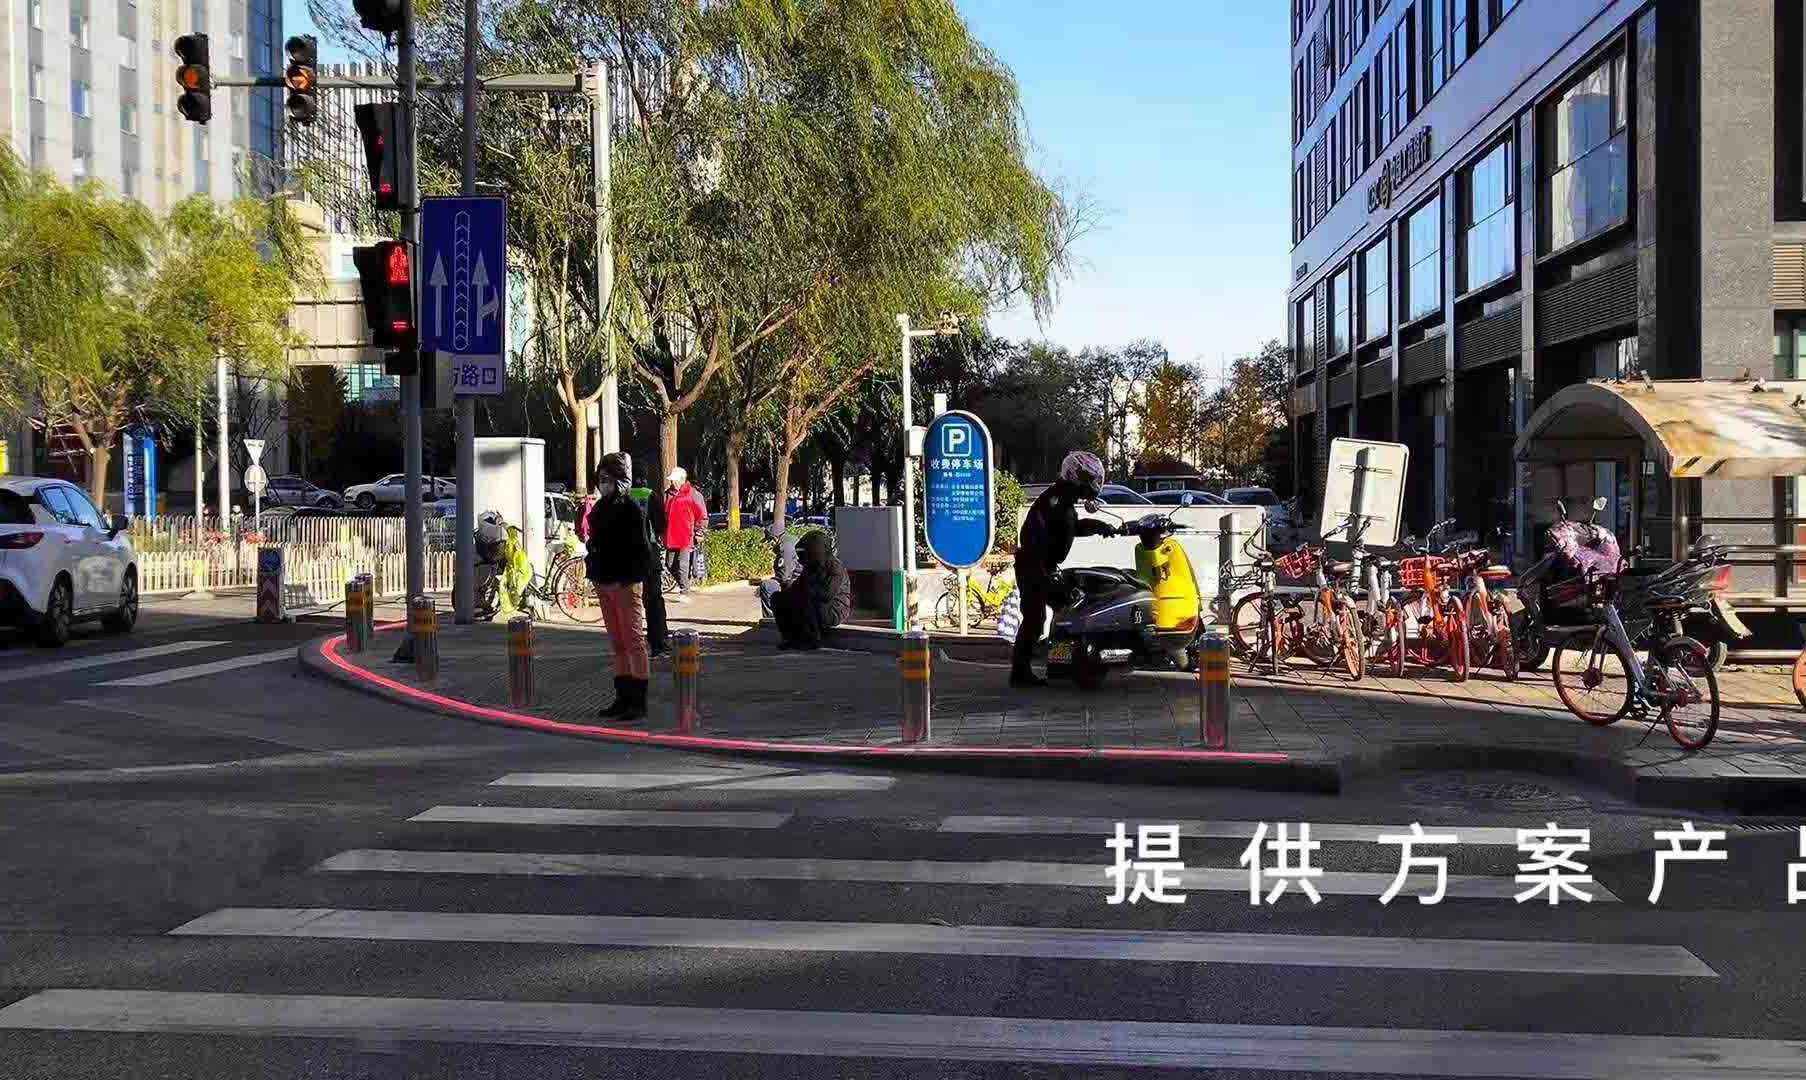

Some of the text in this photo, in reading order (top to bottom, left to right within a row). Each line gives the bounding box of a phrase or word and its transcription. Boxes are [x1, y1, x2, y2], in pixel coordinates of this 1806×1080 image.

[948, 428, 966, 453] P
[930, 458, 984, 471] 收费停车场
